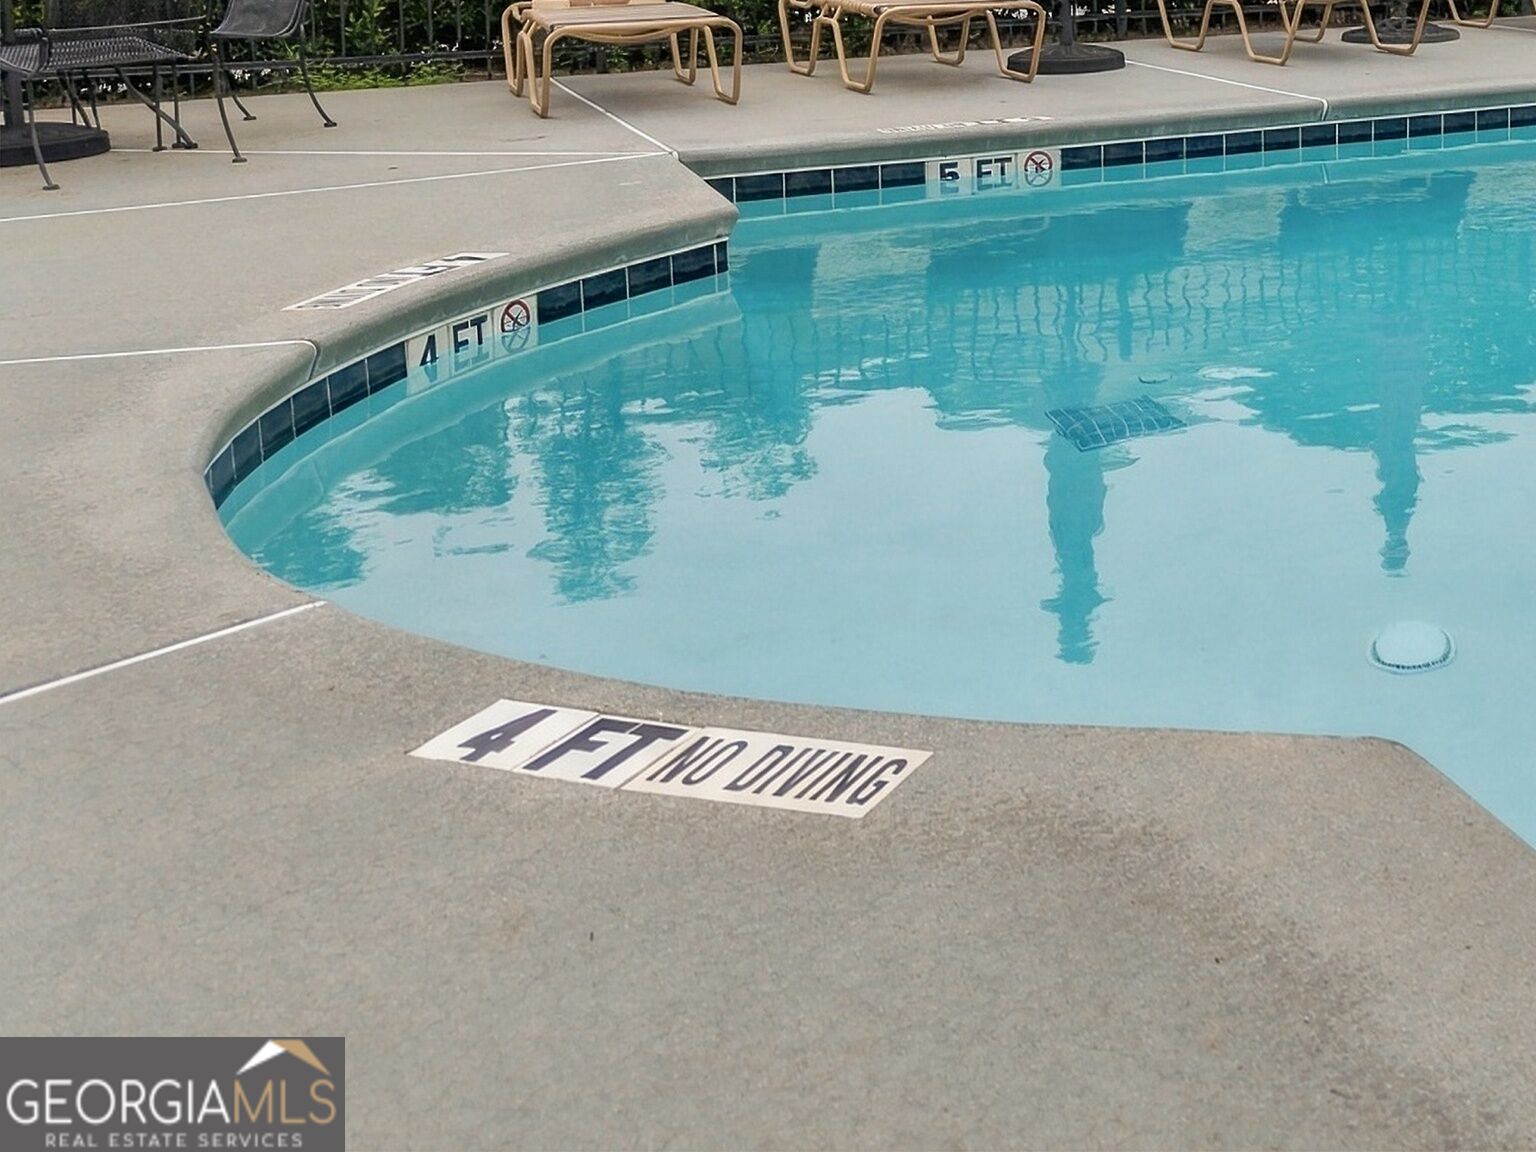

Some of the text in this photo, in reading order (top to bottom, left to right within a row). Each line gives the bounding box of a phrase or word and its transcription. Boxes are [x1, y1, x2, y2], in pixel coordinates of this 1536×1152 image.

[939, 157, 1012, 181] 5 FT
[420, 314, 488, 366] 4 FT
[457, 708, 908, 805] 4 FT NO DIVING
